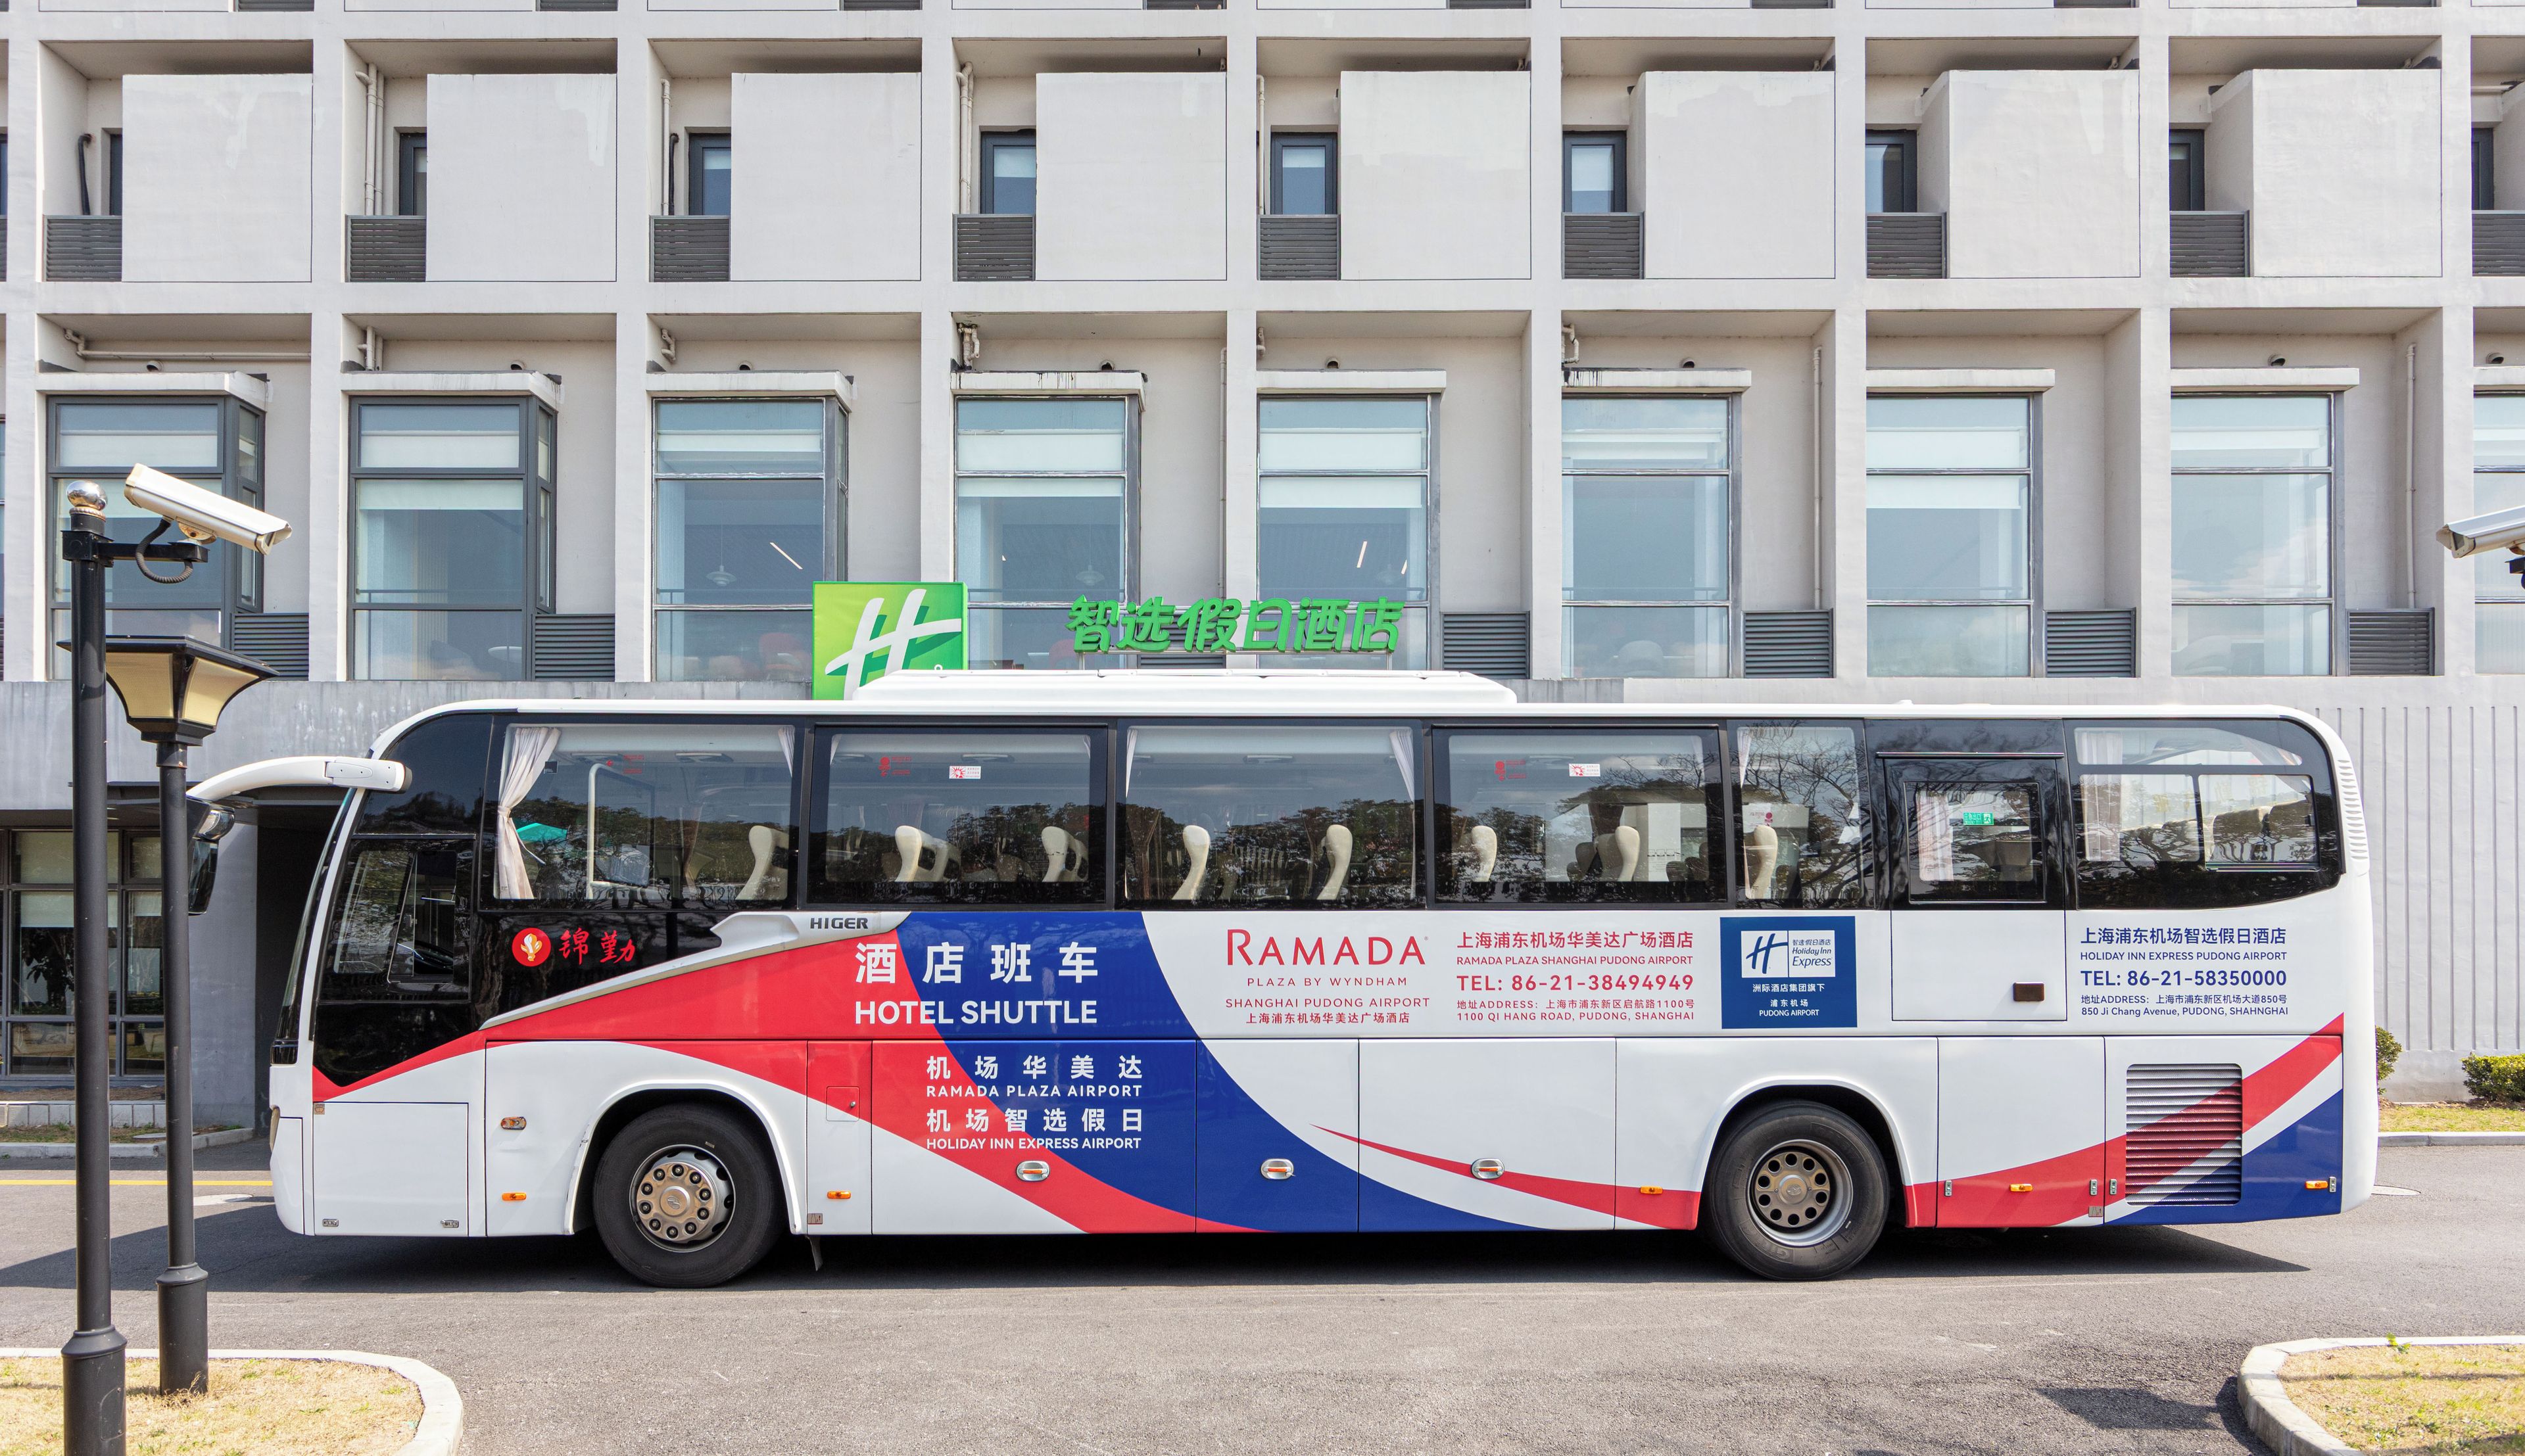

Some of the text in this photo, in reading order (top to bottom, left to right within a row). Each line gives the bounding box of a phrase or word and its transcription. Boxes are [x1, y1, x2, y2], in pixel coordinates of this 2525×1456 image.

[1064, 594, 1406, 653] 智选假日酒店
[810, 918, 868, 929] HIGER
[1456, 931, 1693, 949] 上海浦东机场华美达广场酒店
[2080, 928, 2286, 945] 上海浦东机场智选假日酒店
[558, 927, 636, 966] 锦勤
[1227, 929, 1426, 966] RAMADA
[1792, 947, 1819, 956] Holiday
[1456, 956, 1693, 965] RAMADA PLAZA SHANGHAI PUDONG AIRPORT
[1792, 956, 1831, 968] Express
[2080, 952, 2287, 960] HOLIDAY INN EXPRESS PUDONG AIRPORT
[855, 941, 1098, 984] 酒店班车
[1247, 977, 1407, 986] PLAZA BY WYNDHAM
[1456, 975, 1693, 991] TEL: 86-21-38494949
[2080, 970, 2287, 986] TEL: 86-21-58350000
[1752, 983, 1825, 993] 洲际酒店集团旗下
[1226, 998, 1430, 1008] SHANGHAI PUDONG AIRPORT
[1546, 999, 1695, 1009] 上海市浦东新区启航路1100号
[2155, 995, 2287, 1004] 上海市浦东新区机场大道850号
[855, 1000, 1097, 1024] HOTEL SHUTTLE
[1246, 1012, 1410, 1024] 上海浦东机场华美达广场酒店
[1457, 1012, 1694, 1022] 1100 QI HANG ROAD, PUDONG, SHANGHAI
[2082, 1007, 2288, 1017] 850 Ji Chang Avenue, PUDONG, SHAHNGHAI
[926, 1055, 1143, 1079] 机场华美达
[926, 1085, 1142, 1097] RAMADA PLAZA AIRPORT
[926, 1108, 1142, 1133] 机场智选假日
[926, 1138, 1142, 1150] HOLIDAY INN EXPRESS AIRPORT
